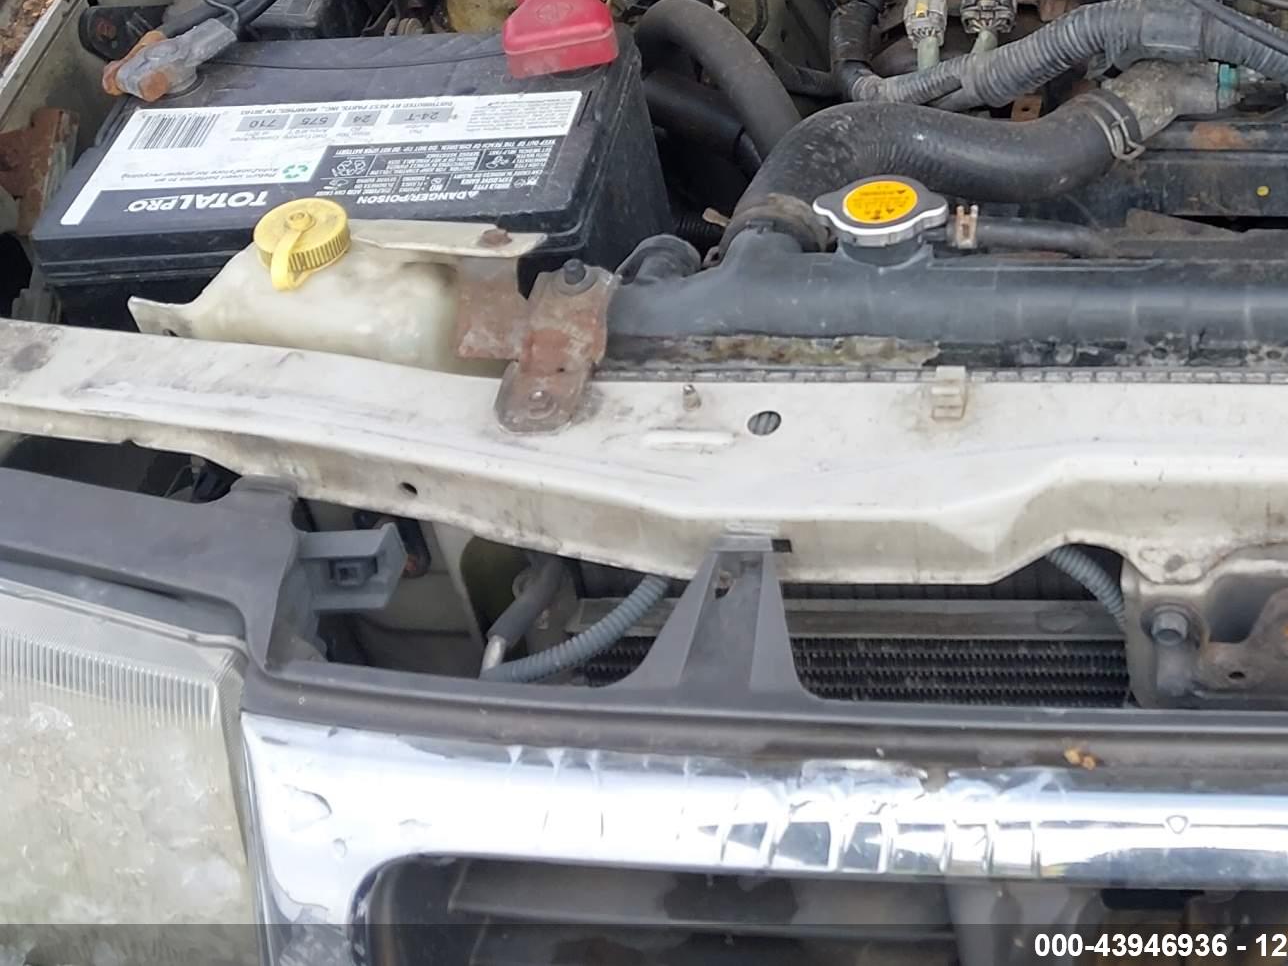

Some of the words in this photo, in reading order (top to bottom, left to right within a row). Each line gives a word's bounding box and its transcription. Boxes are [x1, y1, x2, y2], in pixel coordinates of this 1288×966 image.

[248, 118, 277, 129] 710
[301, 117, 329, 126] 575
[352, 115, 371, 124] 24
[127, 191, 268, 212] TOTALPRO
[356, 190, 467, 204] DANGER/POISON
